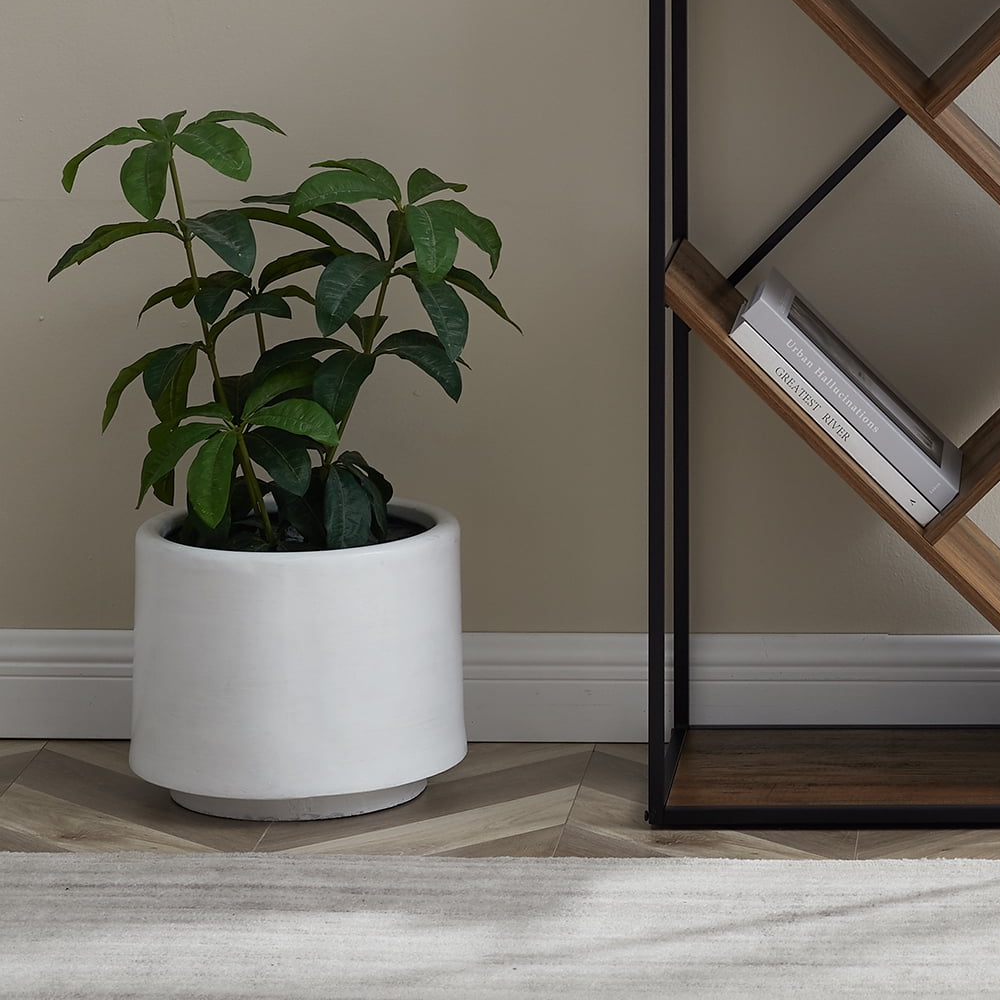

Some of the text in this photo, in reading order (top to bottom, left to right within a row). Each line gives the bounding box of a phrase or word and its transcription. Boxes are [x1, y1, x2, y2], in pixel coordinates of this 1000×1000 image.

[775, 366, 851, 442] GREATEST RIVER
[786, 338, 880, 433] Urban Hallucinations
